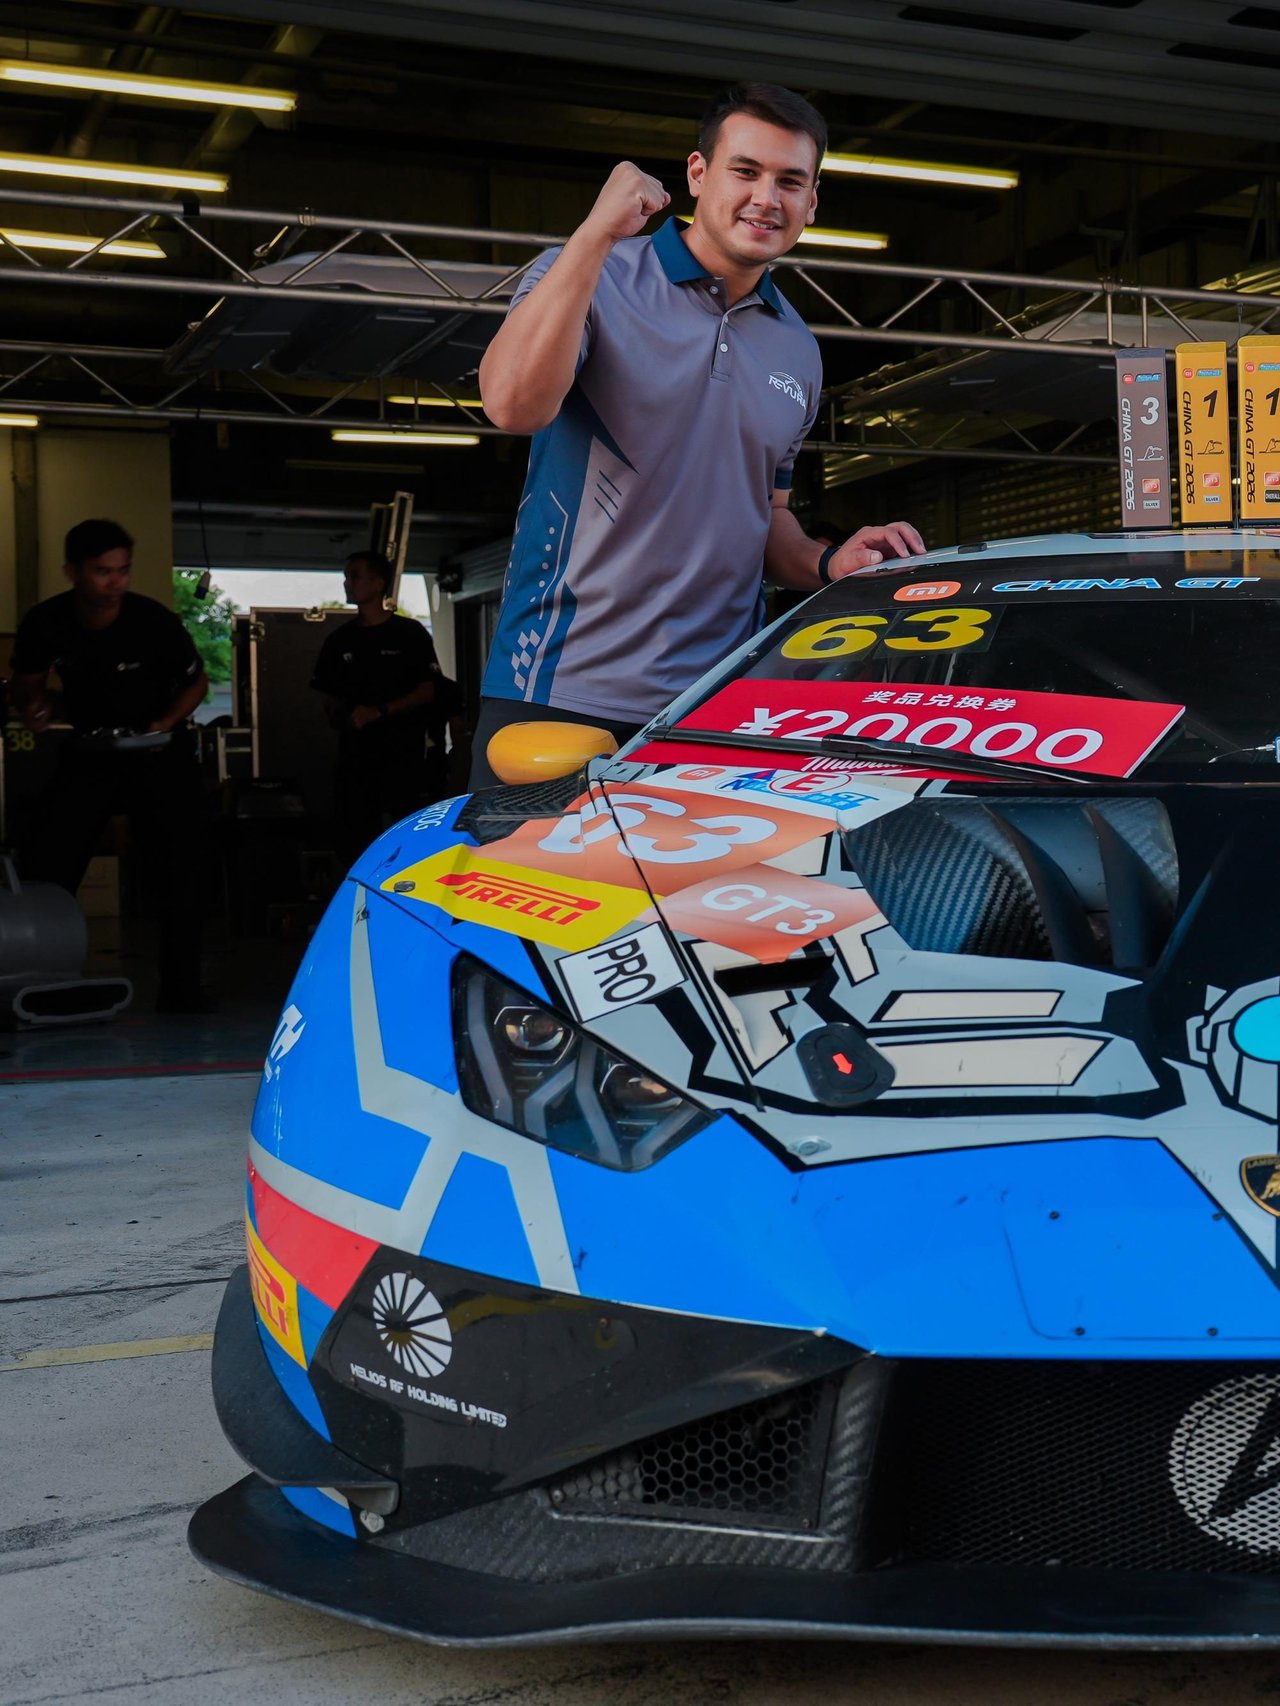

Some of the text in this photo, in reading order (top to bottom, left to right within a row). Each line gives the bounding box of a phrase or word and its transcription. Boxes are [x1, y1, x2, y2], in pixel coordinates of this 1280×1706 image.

[1140, 396, 1160, 426] 3
[1203, 390, 1218, 418] 1
[1265, 387, 1280, 416] 1
[1121, 398, 1135, 511] CHINA GT 2026
[1182, 390, 1196, 504] CHINA GT 2026
[1244, 388, 1256, 504] CHINA GT 2026
[991, 576, 1261, 592] CHINA GT
[780, 608, 992, 659] 63
[861, 690, 1017, 713] 奖品兑换券
[5, 730, 35, 751] 38
[730, 707, 1104, 764] ¥20000
[537, 793, 778, 864] 63
[435, 871, 601, 926] PIRELLI
[702, 883, 836, 936] GT3
[587, 938, 656, 1003] PRO
[350, 1362, 508, 1428] HELIOS RF HOLDING LIMITED
